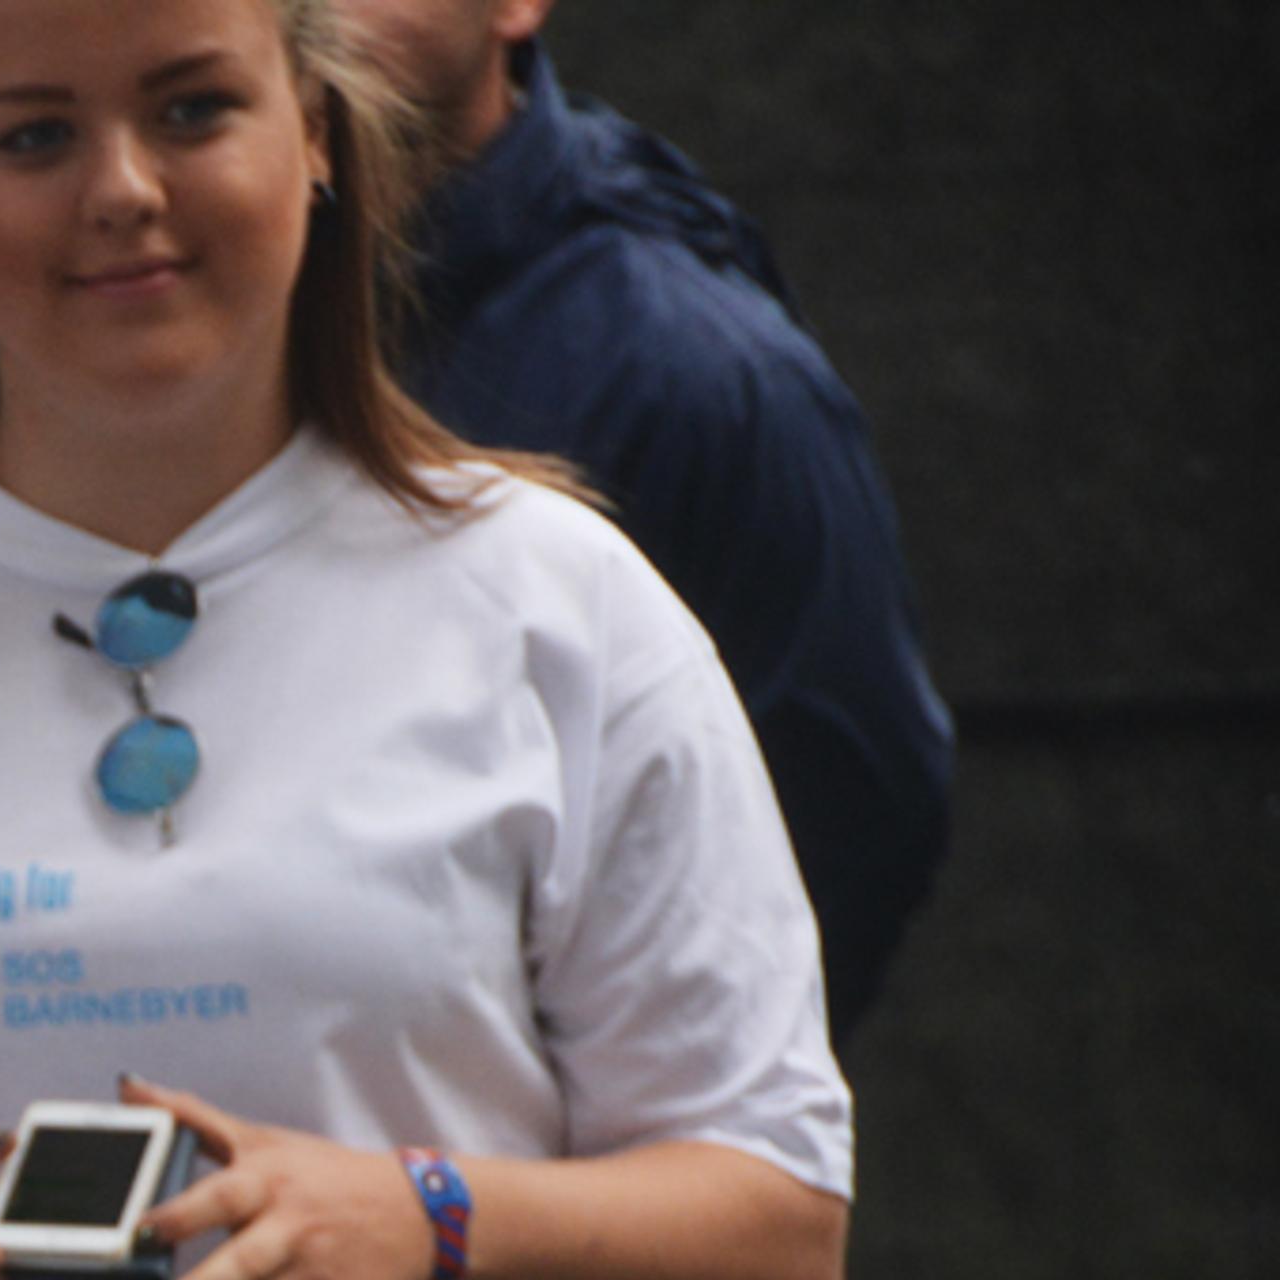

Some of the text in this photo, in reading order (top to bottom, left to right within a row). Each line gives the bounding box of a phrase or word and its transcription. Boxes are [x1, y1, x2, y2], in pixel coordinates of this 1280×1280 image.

[27, 862, 75, 911] for
[2, 949, 83, 983] SOS
[3, 983, 248, 1027] BARNEBYER
